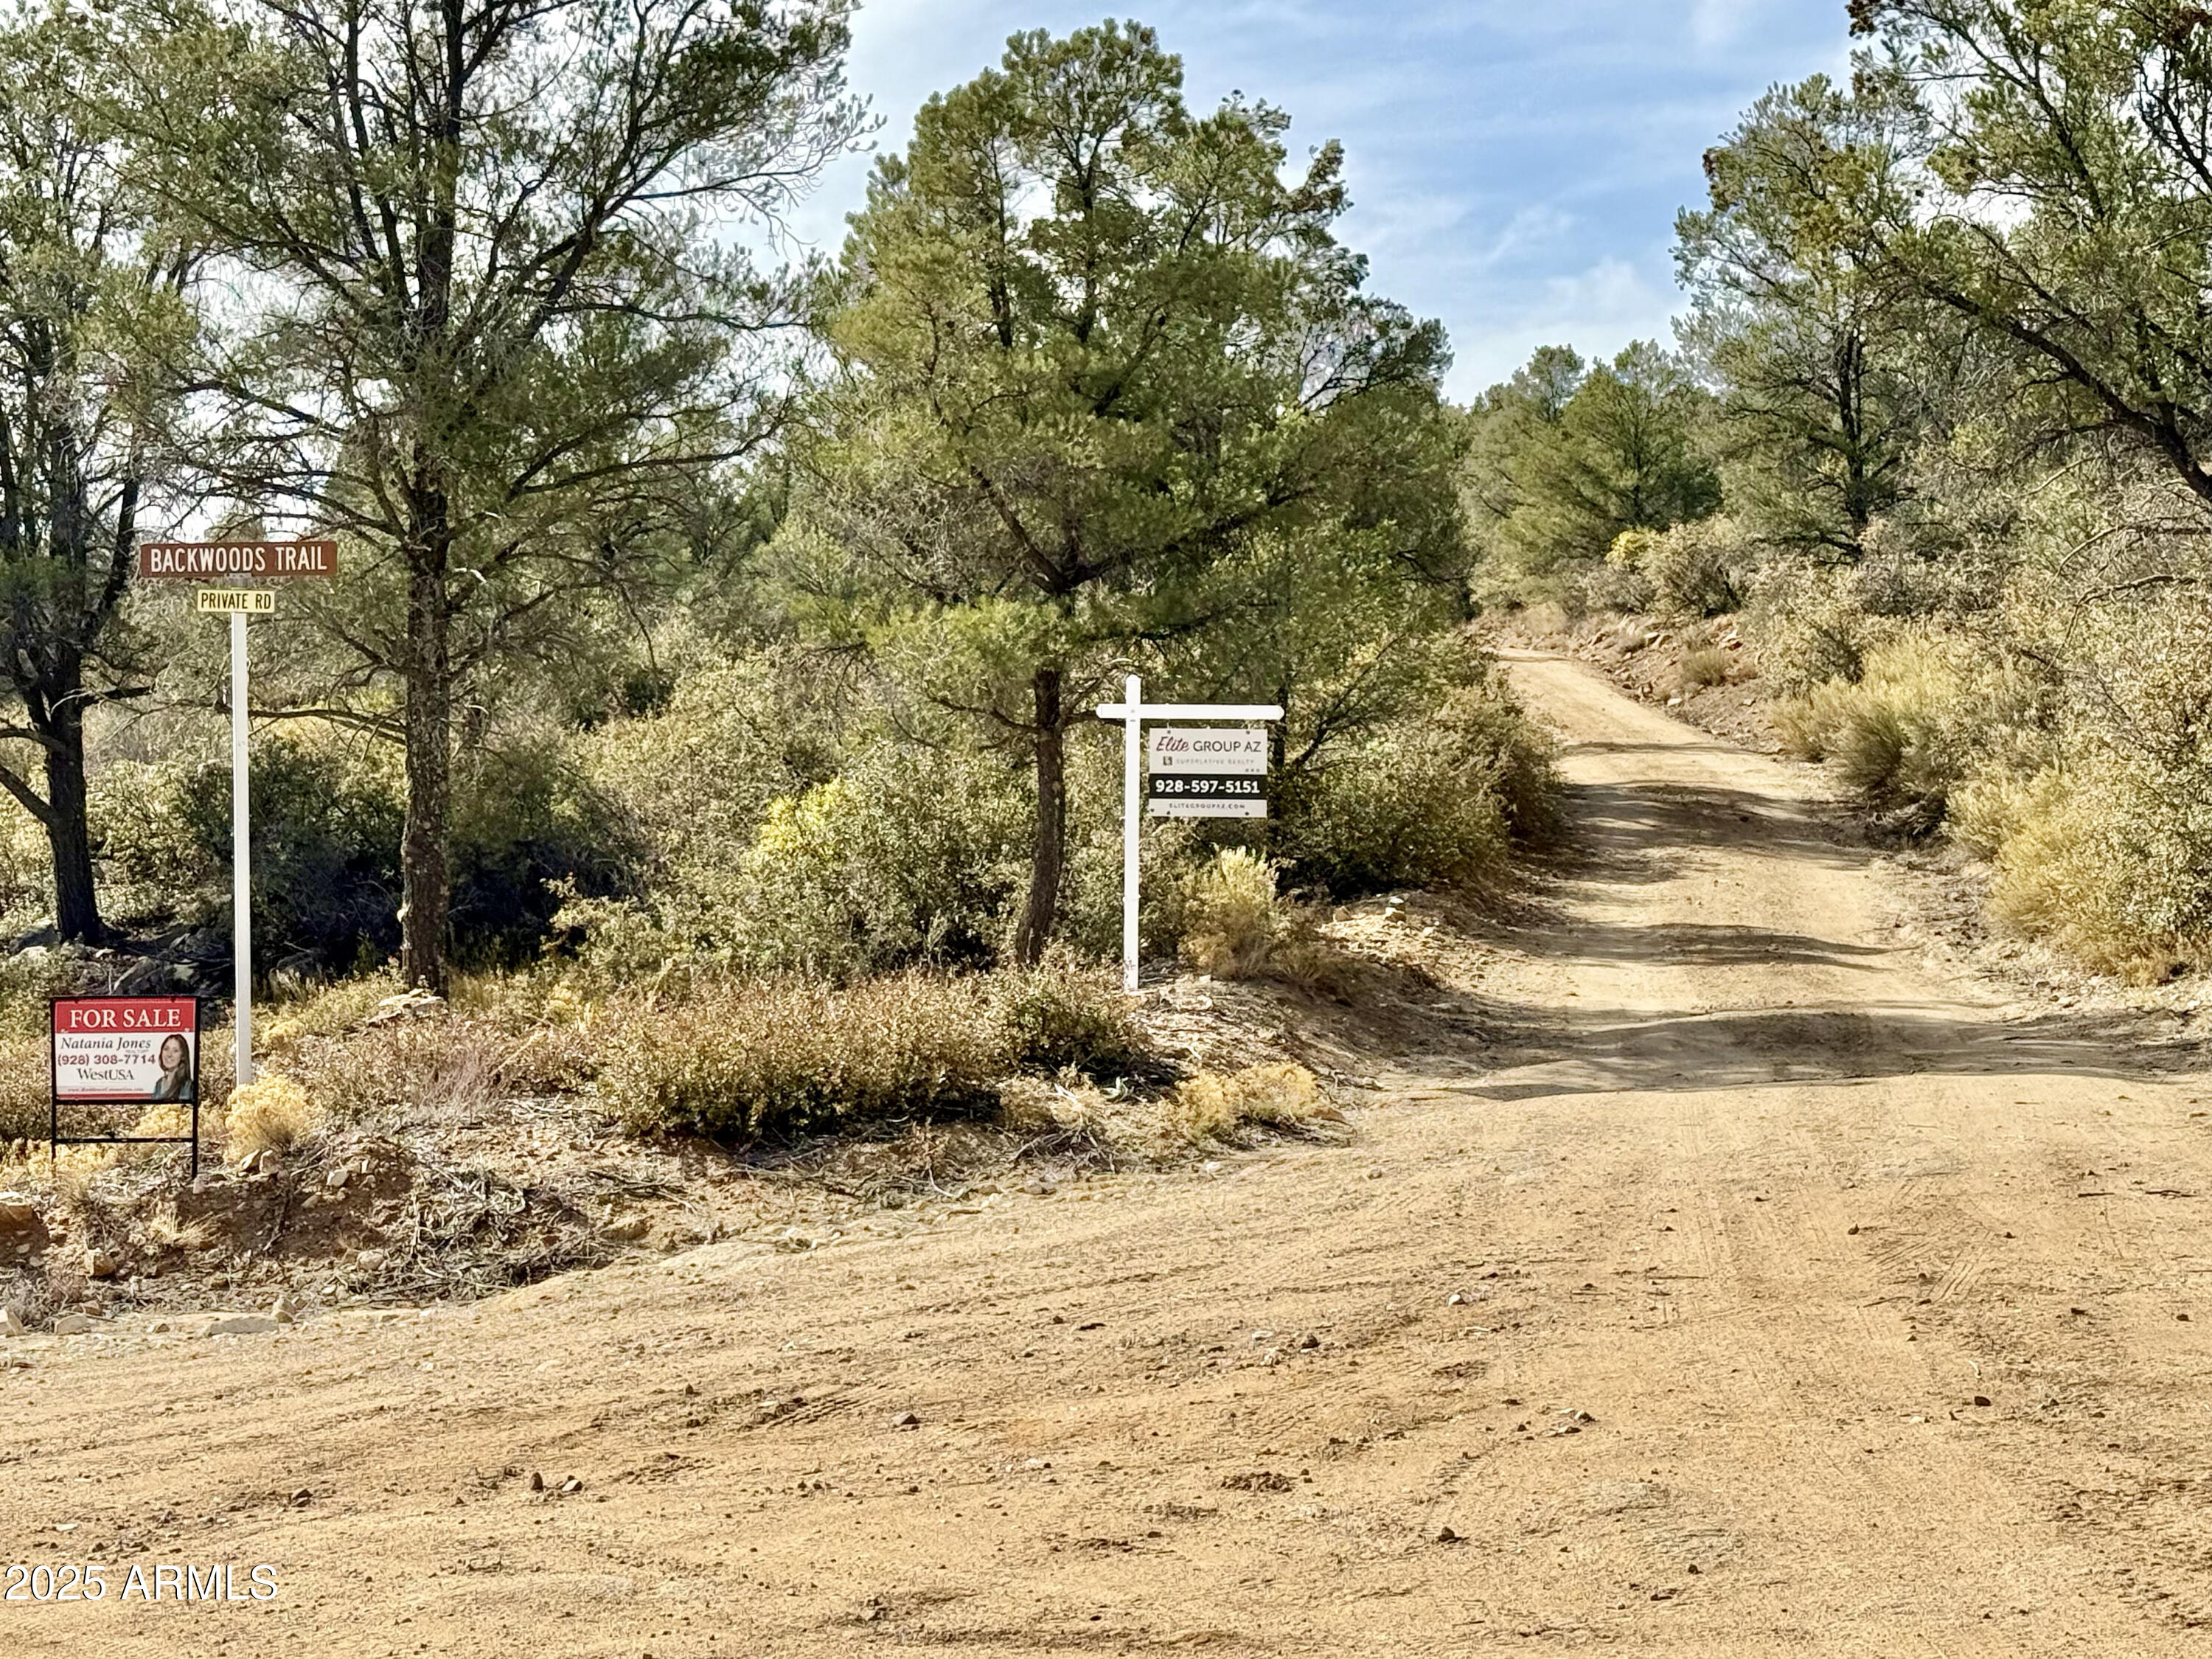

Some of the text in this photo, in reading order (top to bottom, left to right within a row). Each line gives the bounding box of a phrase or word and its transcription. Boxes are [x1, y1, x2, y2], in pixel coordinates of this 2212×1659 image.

[150, 546, 327, 572] BACKWOODS TRAIL
[201, 593, 271, 609] PRIVATE RD
[1156, 736, 1262, 753] Elite GROUP AZ
[1155, 779, 1260, 793] 928-597-5151
[70, 1009, 181, 1028] FOR SALE
[60, 1037, 151, 1051] Natania Jones
[58, 1054, 156, 1066] (928) 308-7714
[77, 1068, 136, 1081] WestUSA
